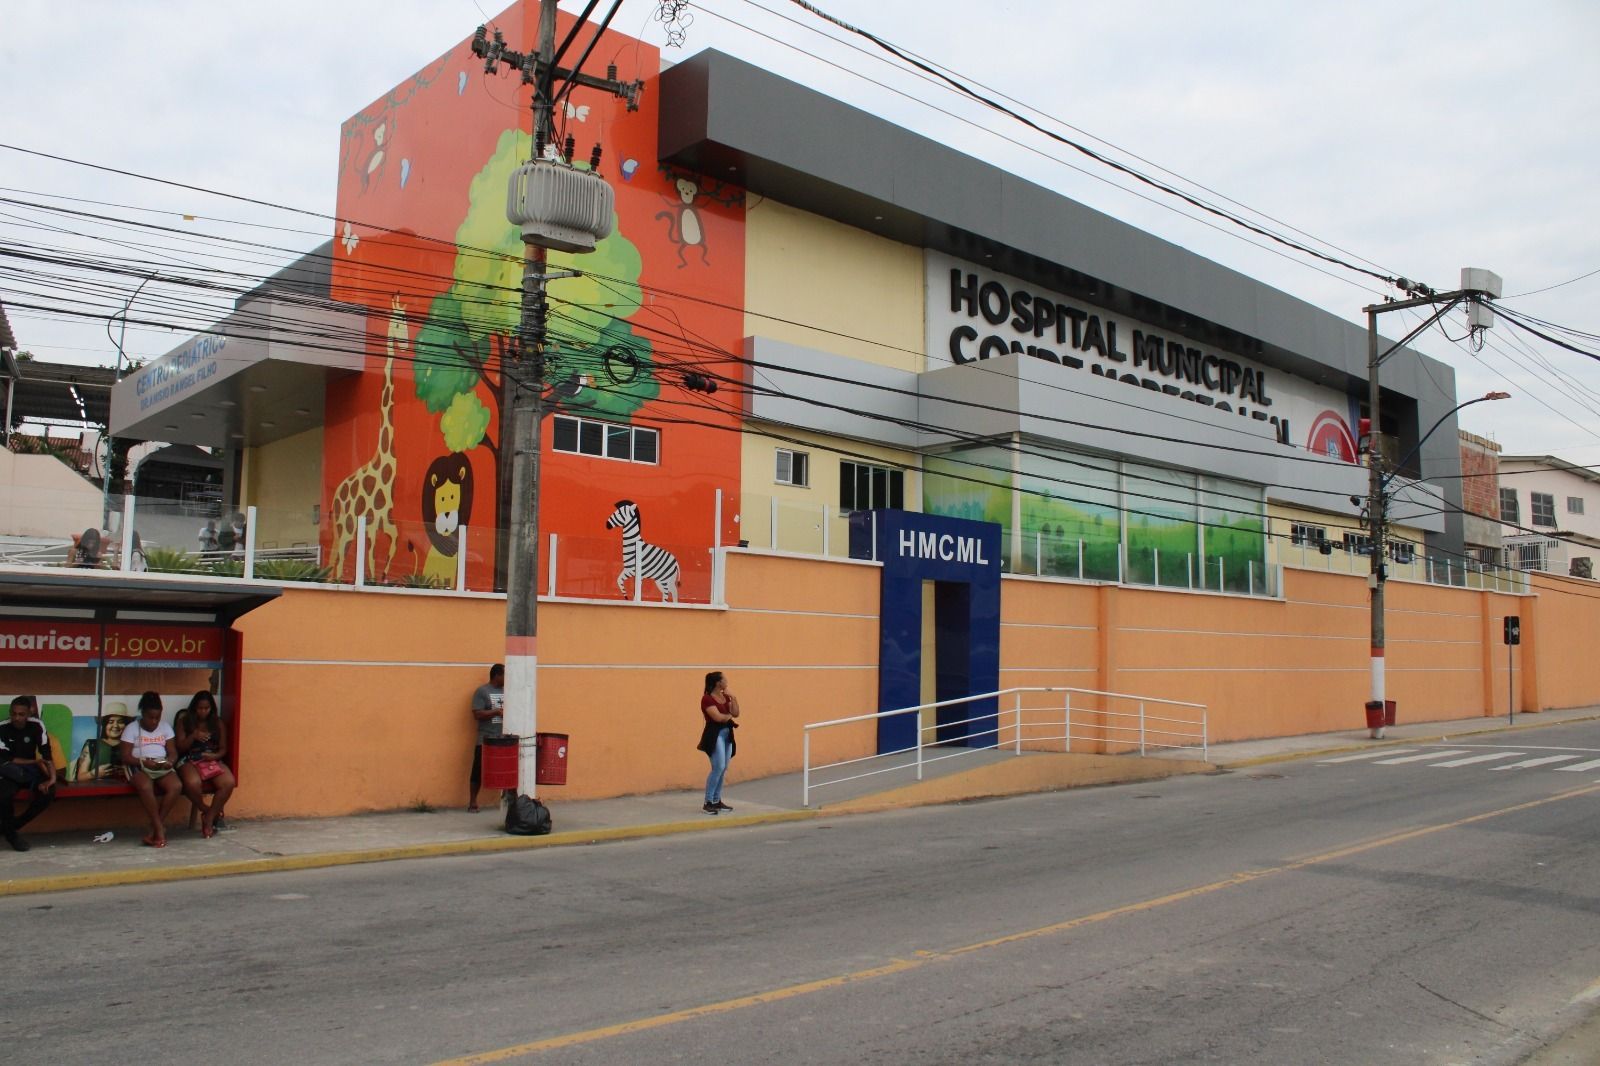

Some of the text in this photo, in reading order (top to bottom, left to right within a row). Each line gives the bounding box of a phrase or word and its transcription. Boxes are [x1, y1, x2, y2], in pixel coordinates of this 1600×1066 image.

[950, 268, 1127, 363] HOSPITAL
[1132, 328, 1272, 407] MUNICIPAL
[136, 364, 170, 397] CENTRO
[196, 361, 217, 382] FILHO
[899, 528, 989, 566] HMCML
